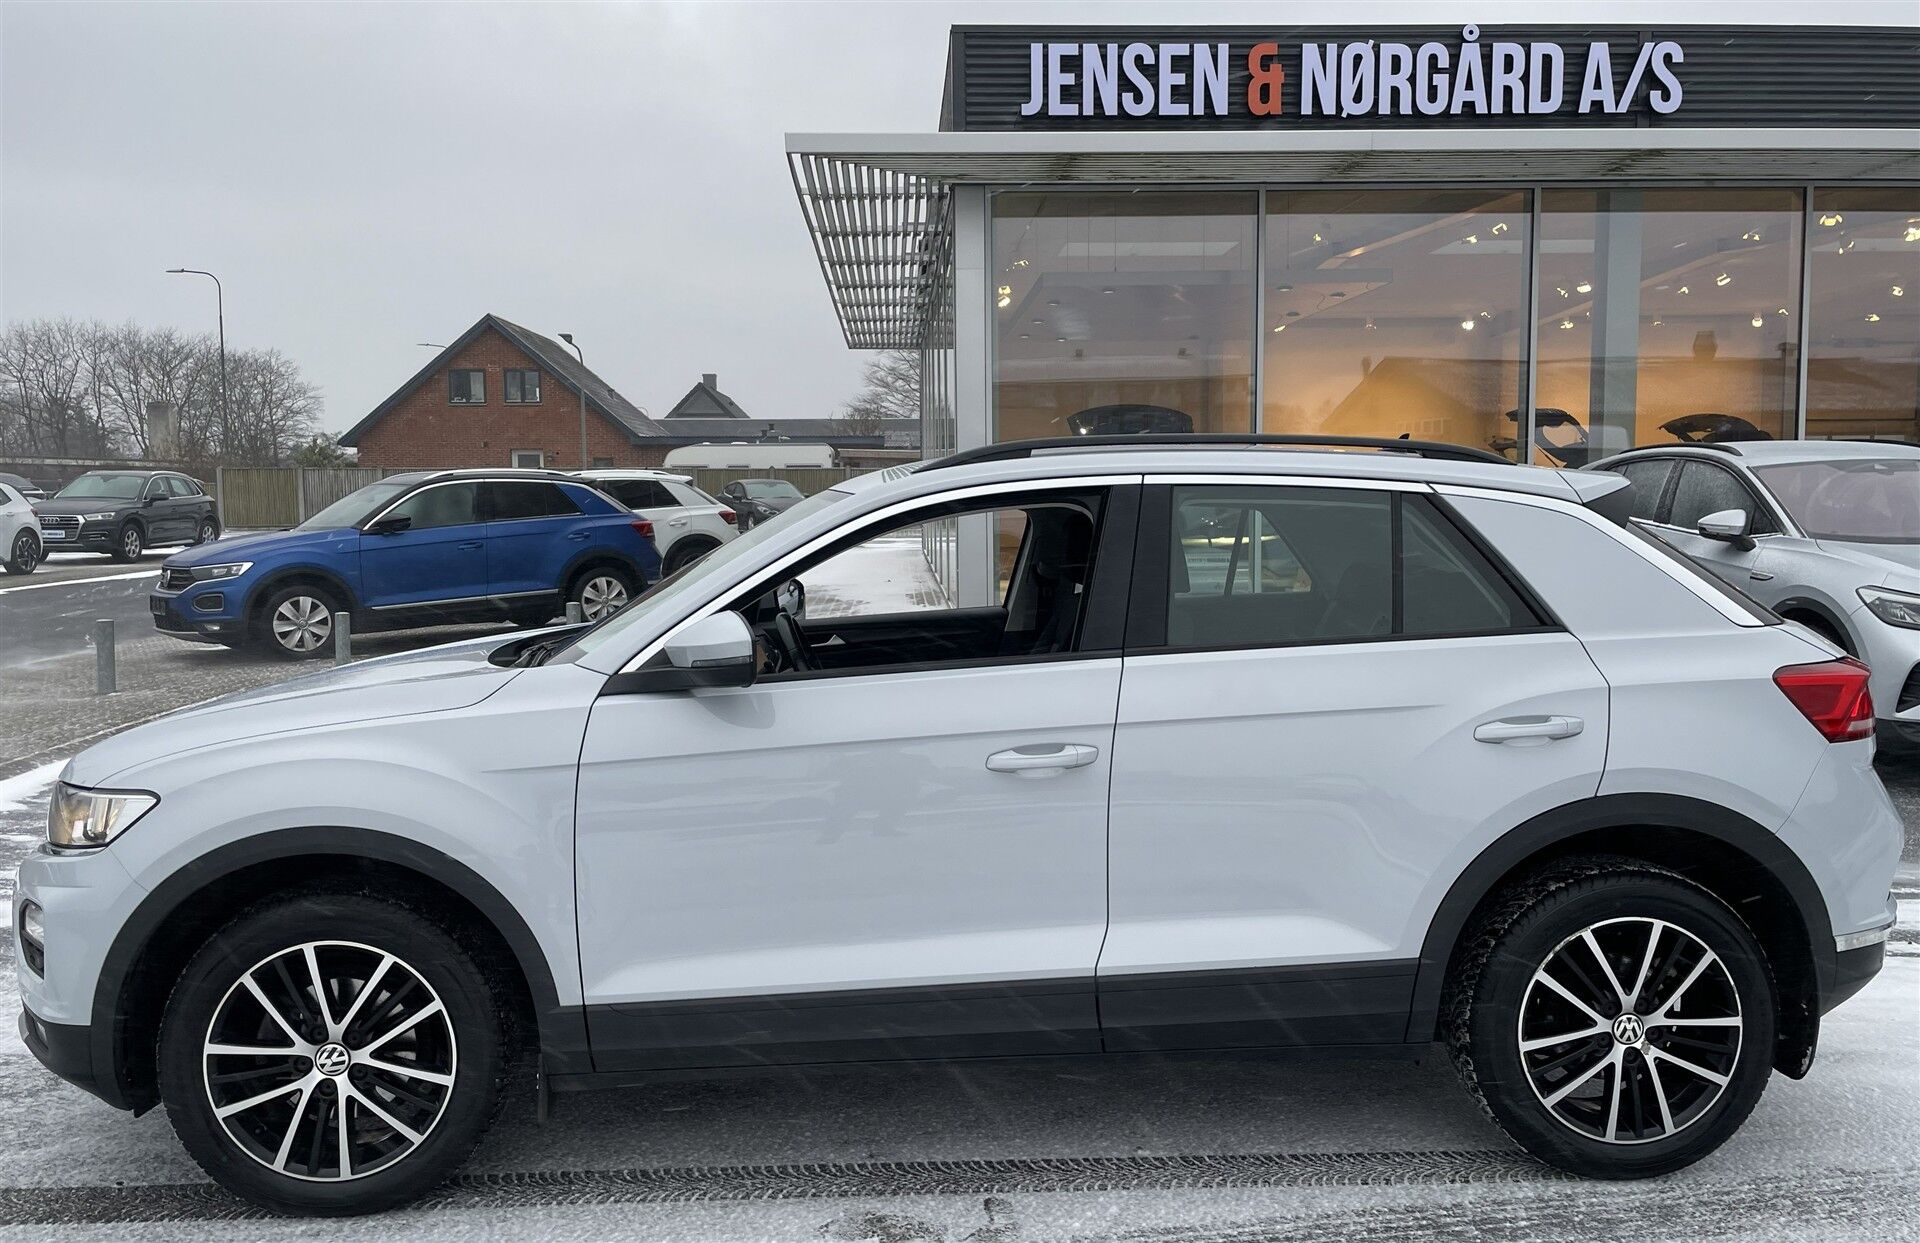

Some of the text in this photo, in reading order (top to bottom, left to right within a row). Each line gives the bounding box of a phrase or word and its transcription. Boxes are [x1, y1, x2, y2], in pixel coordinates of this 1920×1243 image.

[1020, 23, 1685, 117] JENSEN & NØRGÅRD A/S
